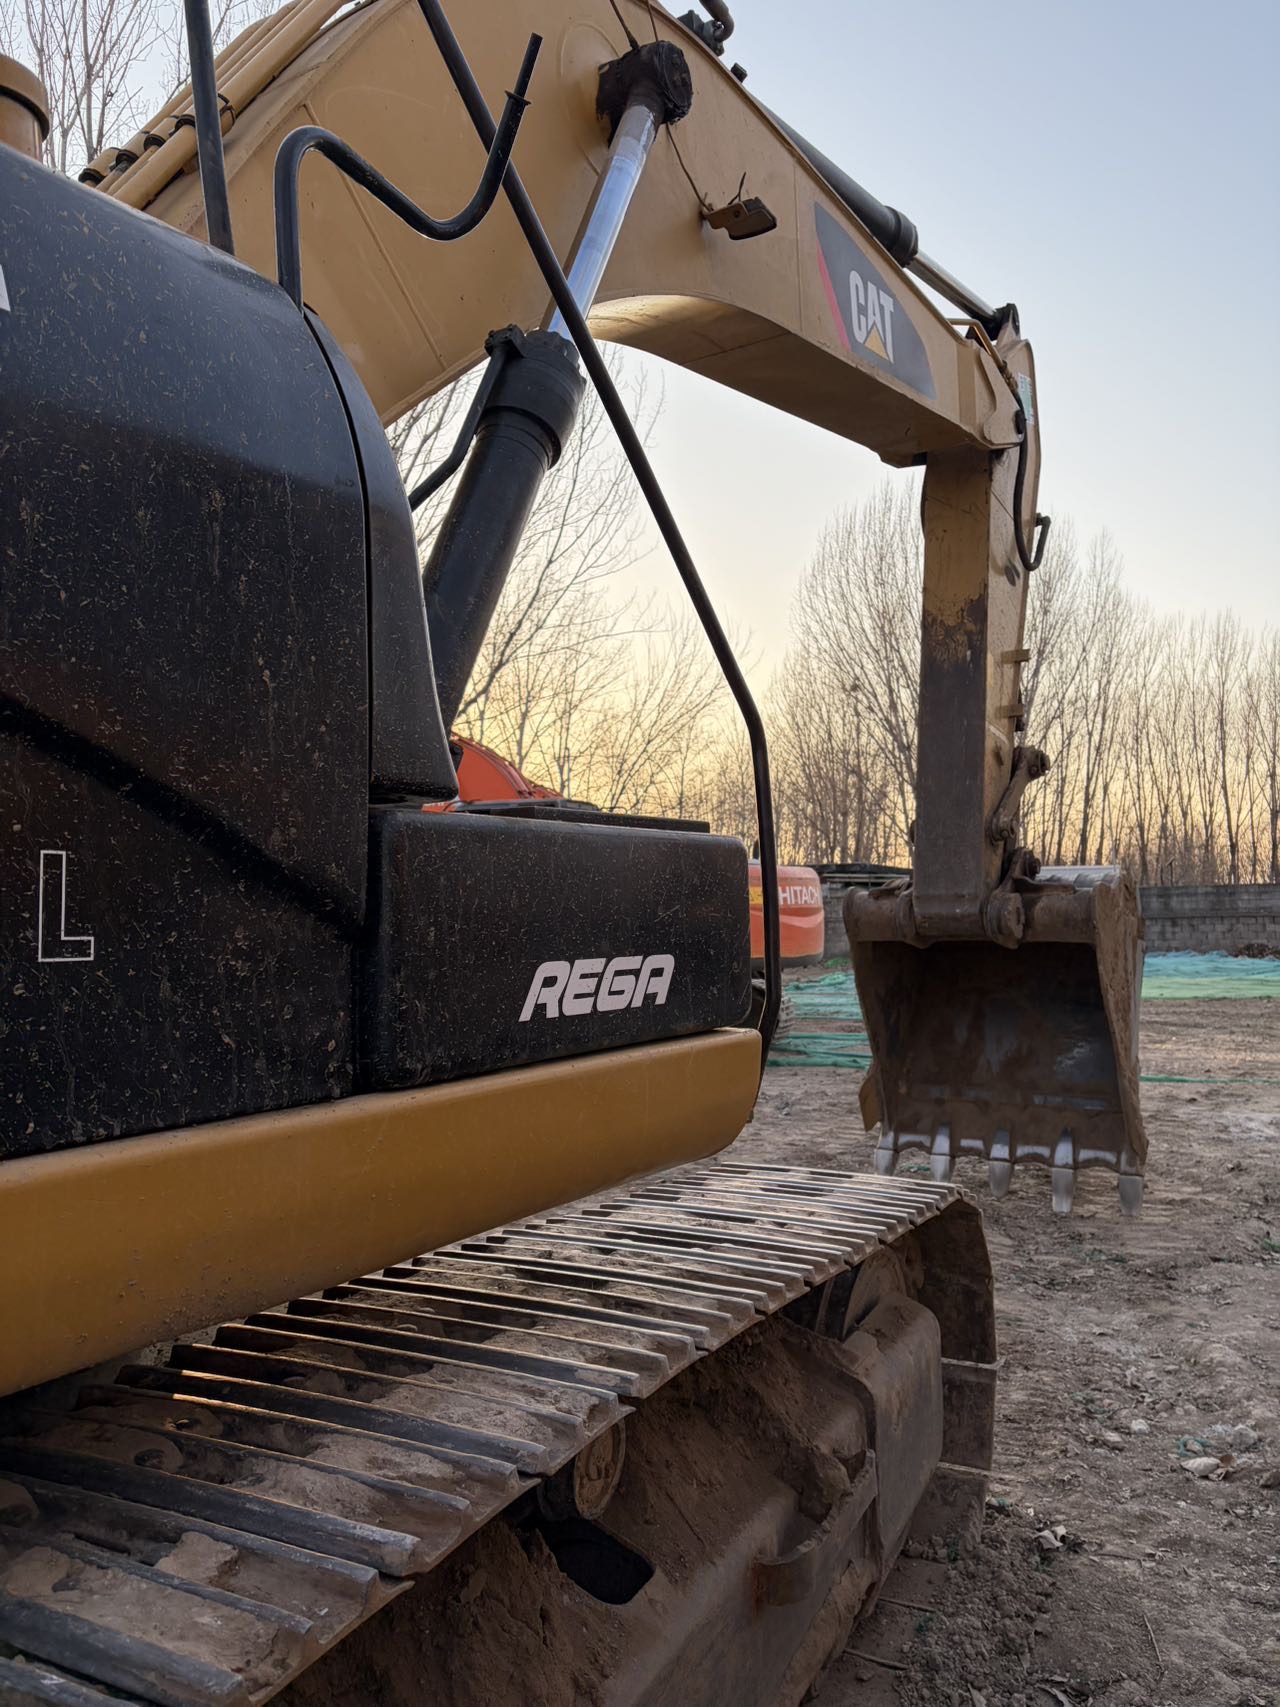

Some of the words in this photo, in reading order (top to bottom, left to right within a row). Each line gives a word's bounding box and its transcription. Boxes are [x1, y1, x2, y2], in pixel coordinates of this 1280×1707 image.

[849, 270, 894, 364] CAT
[38, 850, 94, 962] L
[518, 953, 675, 1022] REGA
